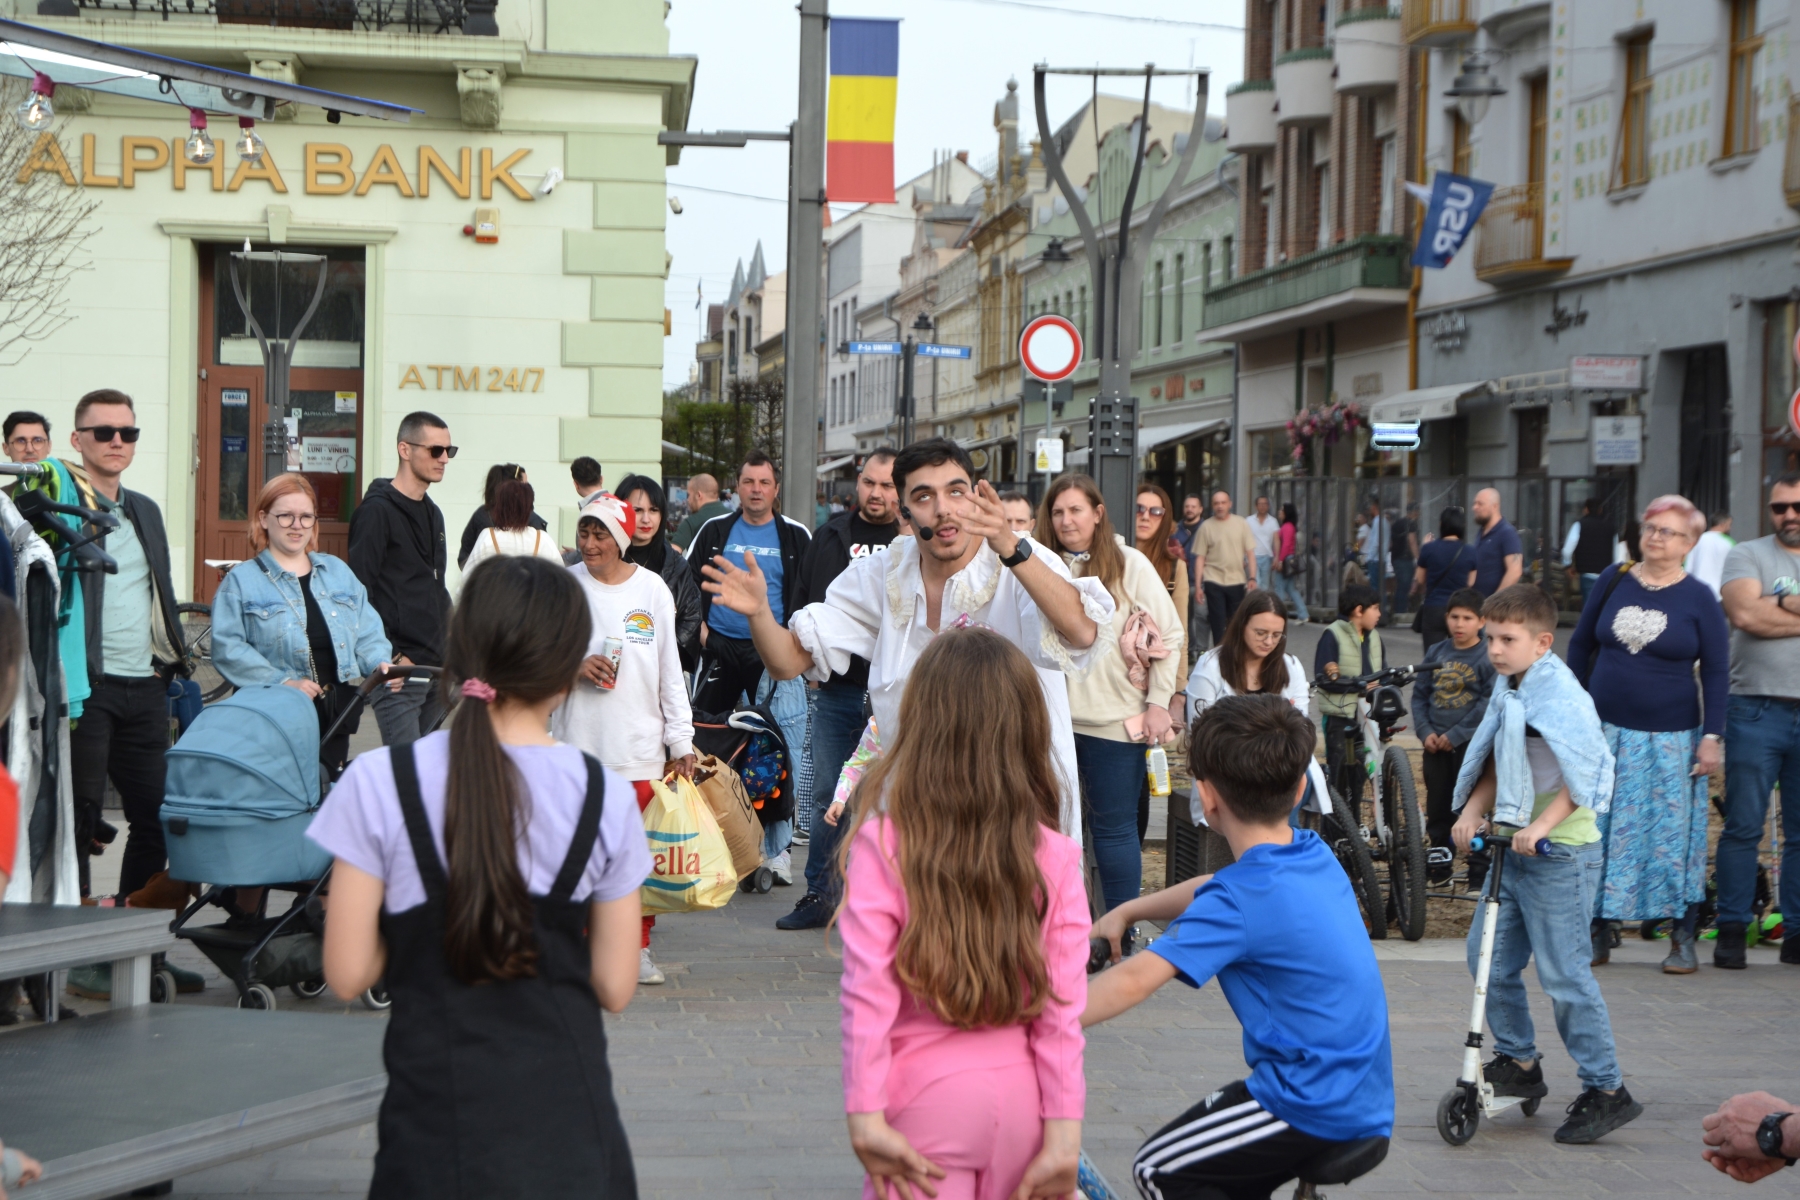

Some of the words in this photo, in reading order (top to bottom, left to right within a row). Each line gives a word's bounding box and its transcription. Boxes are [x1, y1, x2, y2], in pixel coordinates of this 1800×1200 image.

[16, 132, 288, 193] ALPHA
[304, 142, 536, 201] BANK
[873, 343, 893, 352] UNIRII
[398, 364, 480, 391] ATM
[487, 366, 545, 393] 24/7
